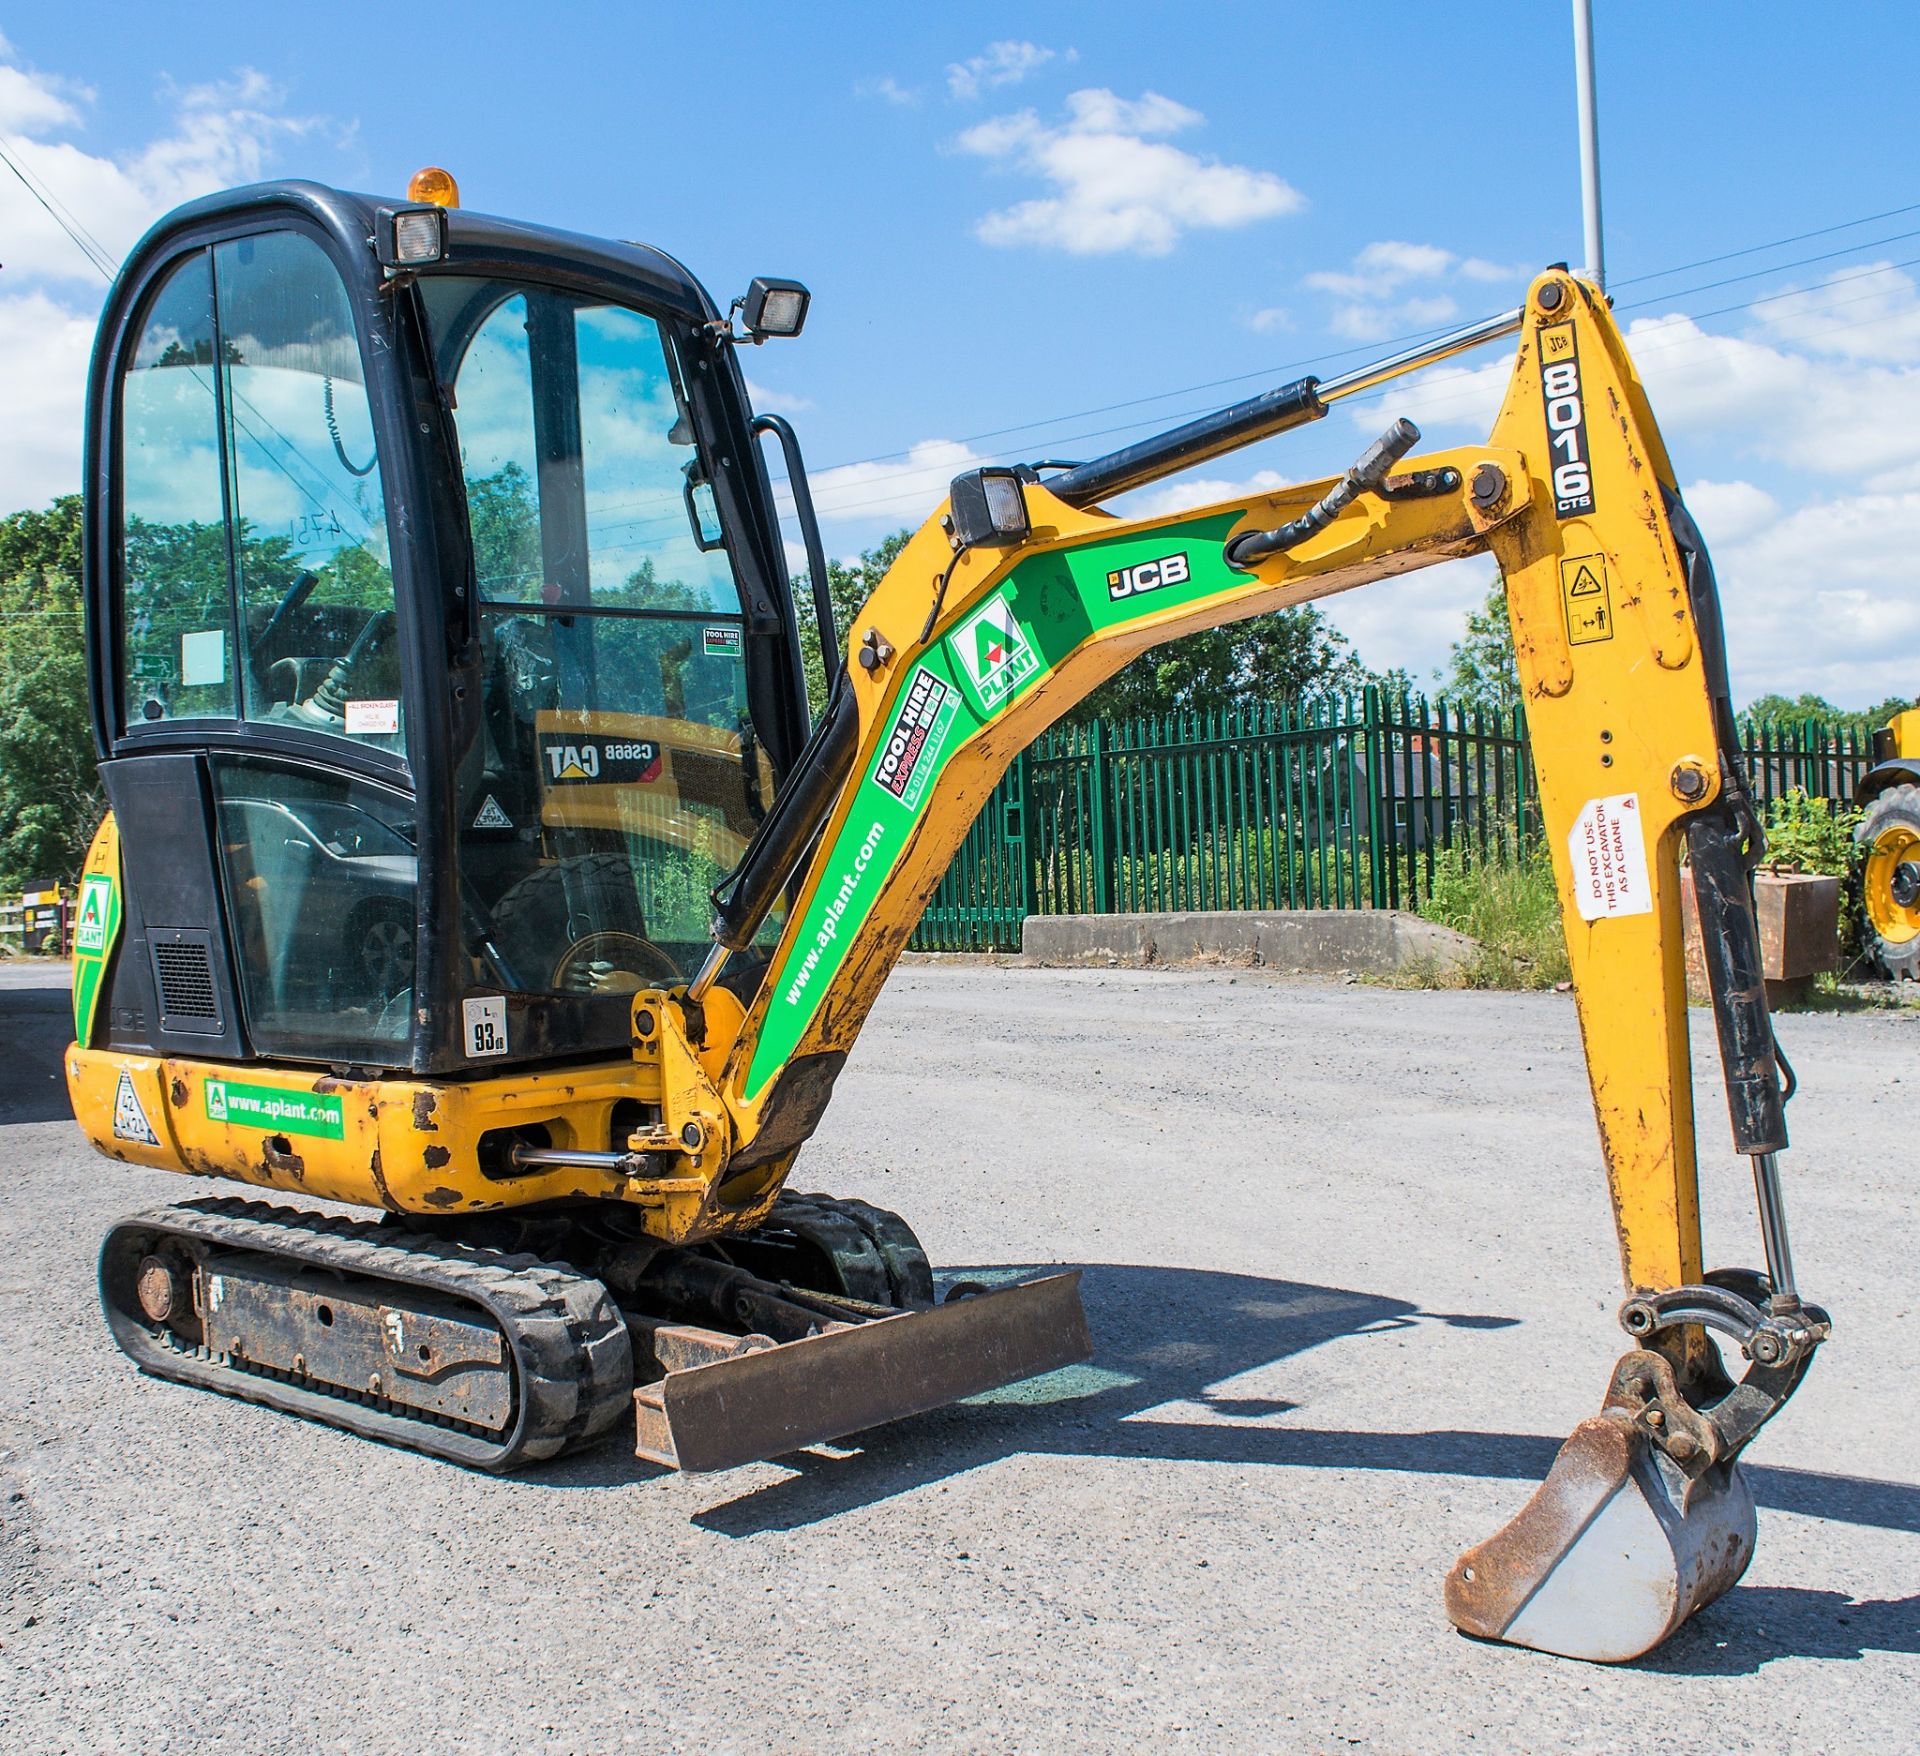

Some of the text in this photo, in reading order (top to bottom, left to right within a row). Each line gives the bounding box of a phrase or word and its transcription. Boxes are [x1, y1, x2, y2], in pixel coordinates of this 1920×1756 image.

[1548, 335, 1569, 352] JCB
[1543, 362, 1590, 499] 8016
[1110, 555, 1188, 598] JCB
[705, 630, 739, 640] TOOL HIRE
[975, 618, 1022, 680] A
[979, 648, 1034, 704] PLANT
[877, 673, 934, 785] TOOL HIRE
[891, 725, 926, 795] EXPRESS
[924, 744, 936, 764] 244
[1584, 820, 1603, 898] DO NOT USE
[1595, 803, 1617, 911] THIS EXCAVATOR
[1611, 817, 1629, 893] AS A CRANE
[785, 821, 885, 1006] www.aplant.com
[227, 1095, 340, 1124] www.aplant.com
